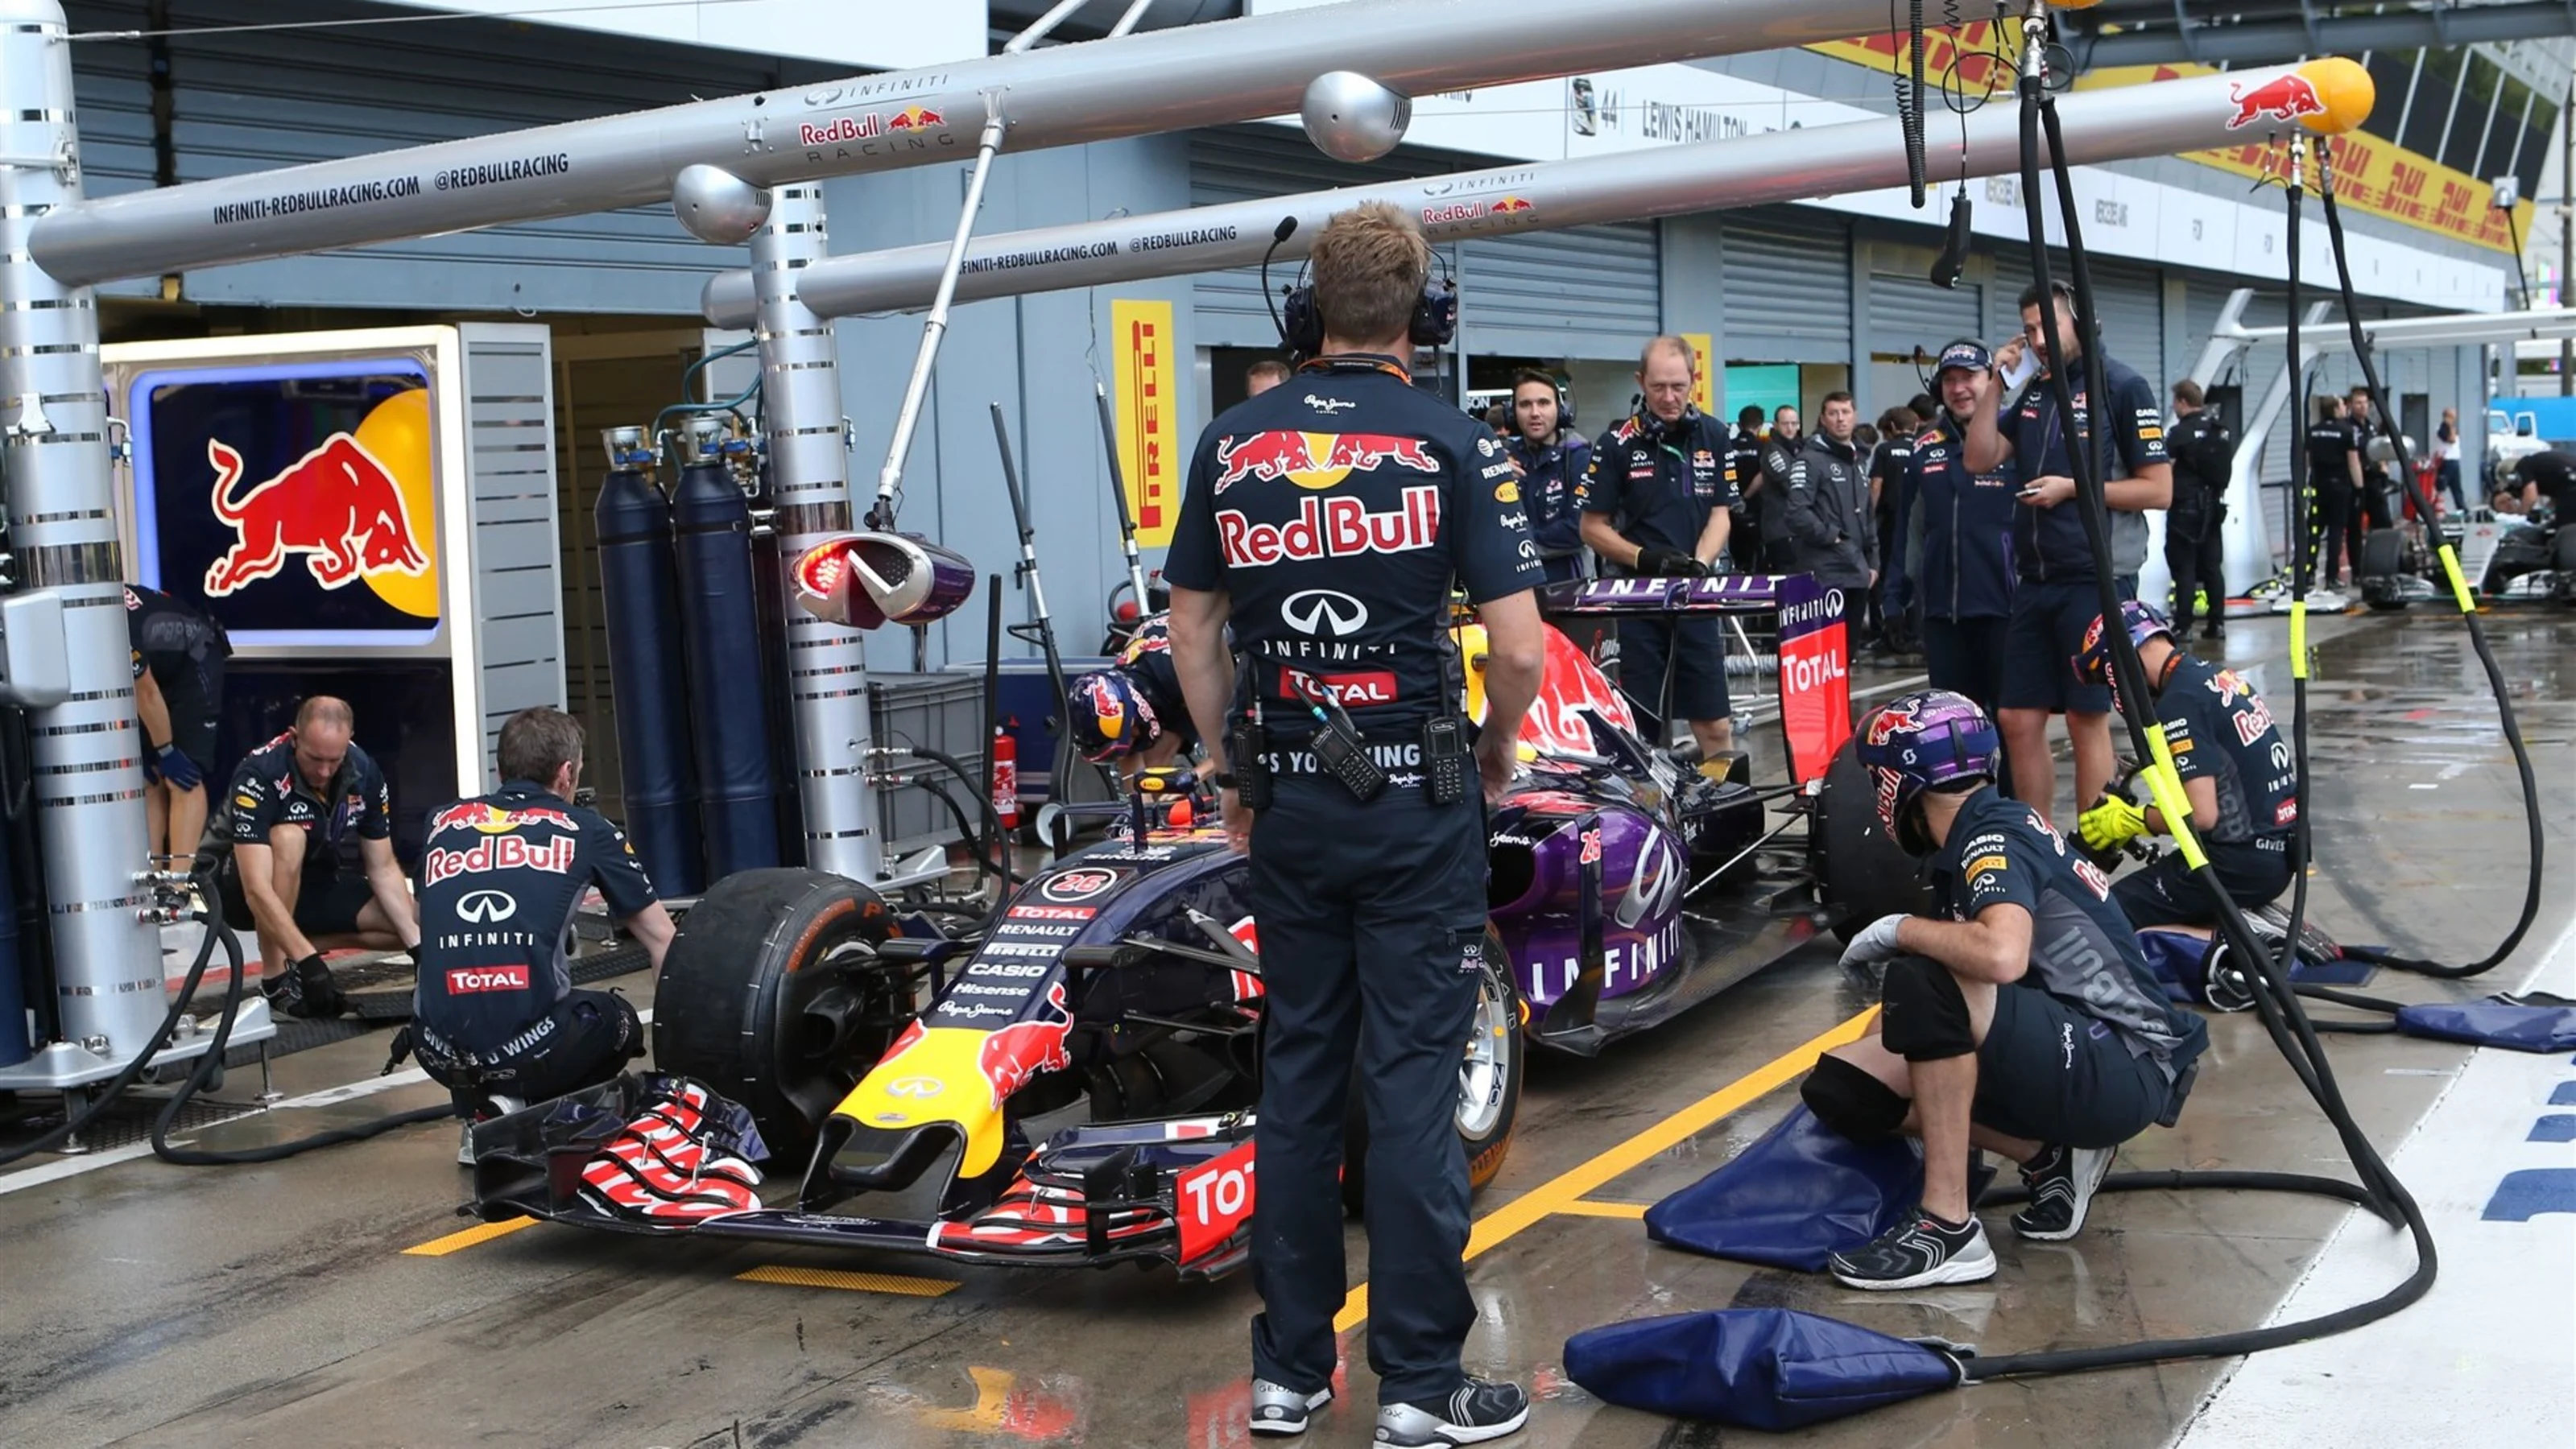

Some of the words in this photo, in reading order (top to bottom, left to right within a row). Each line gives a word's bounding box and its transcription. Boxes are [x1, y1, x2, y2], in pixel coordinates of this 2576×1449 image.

[850, 74, 949, 97] INFINITI
[1601, 89, 1618, 130] 44
[1642, 99, 1682, 142] LEWIS
[806, 133, 954, 163] RACING
[213, 175, 420, 225] INFINITI-REDBULLRACING.COM
[434, 153, 569, 191] @REDBULLRACING
[1459, 172, 1534, 189] INFINITI
[1427, 215, 1539, 235] RACING
[958, 242, 1118, 275] FINITI-REDBULLRACING.COM
[1130, 225, 1237, 254] @REDBULLRACING
[1132, 320, 1161, 528] PIRELLI
[1482, 461, 1513, 480] RENAU
[1216, 495, 1325, 568] Red
[1325, 485, 1441, 557] Bull
[1779, 598, 1825, 629] INFINITI
[1782, 648, 1845, 695] TOTAL
[1288, 670, 1391, 702] TOTAL
[2163, 717, 2188, 732] ASIO
[1289, 750, 1325, 774] YO
[1580, 828, 1602, 864] 26
[426, 835, 493, 887] Red
[495, 834, 576, 874] Bull
[1051, 874, 1108, 893] 26
[2072, 859, 2110, 902] Re
[1015, 906, 1090, 920] TOTAL
[440, 932, 535, 950] INFINITI
[998, 924, 1081, 936] RENAULT
[983, 942, 1063, 957] PIRELLI
[451, 972, 524, 989] TOTAL
[968, 963, 1048, 977] CASIO
[952, 983, 1031, 997] Hisense
[502, 1016, 556, 1059] WINGS
